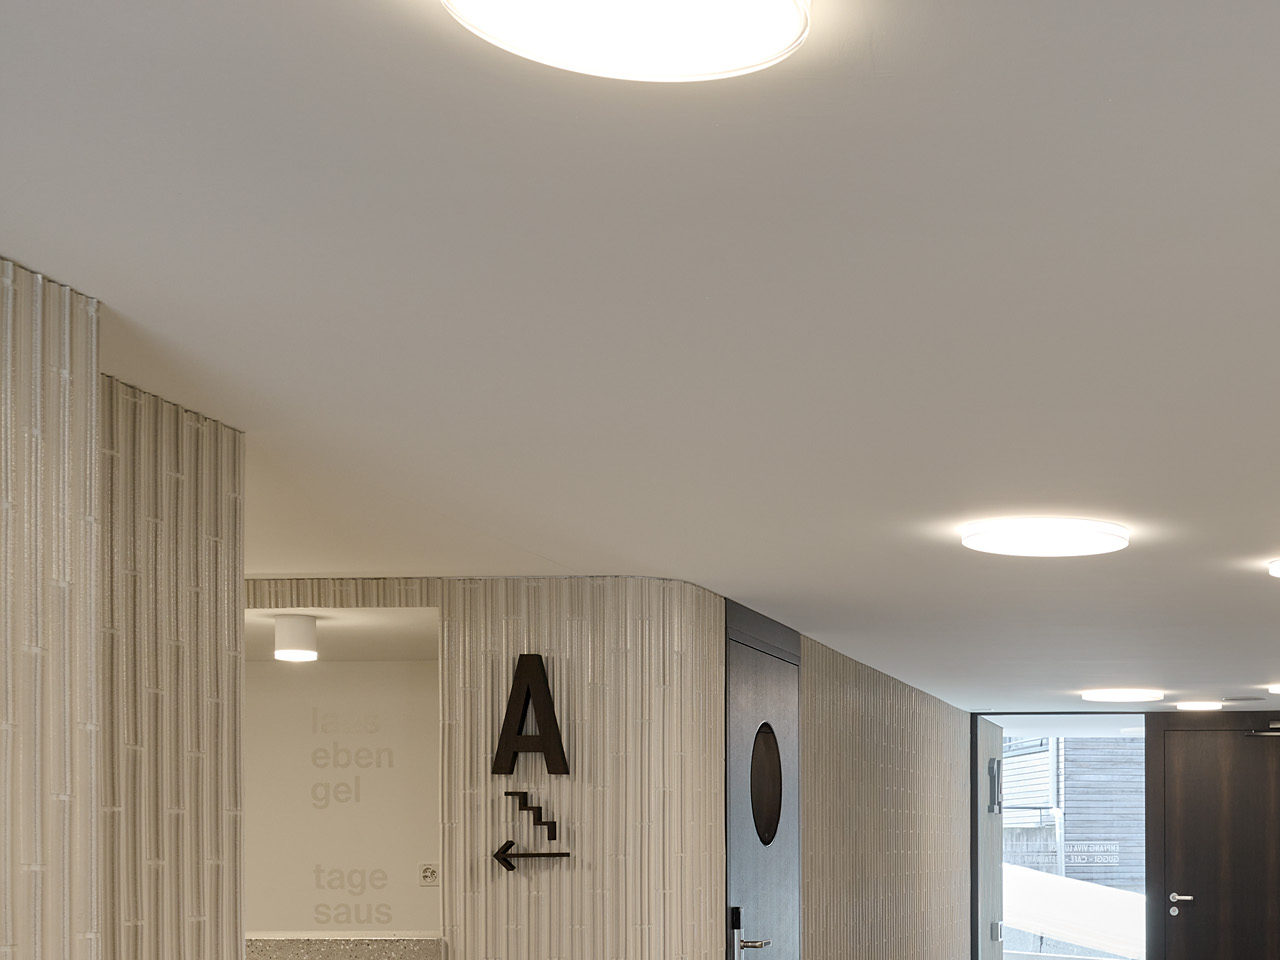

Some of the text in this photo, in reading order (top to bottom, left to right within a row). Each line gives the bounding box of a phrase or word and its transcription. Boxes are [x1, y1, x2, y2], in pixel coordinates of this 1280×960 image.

[491, 654, 570, 774] A
[311, 742, 394, 769] eben
[311, 775, 361, 810] gel
[313, 863, 388, 896] tage
[314, 902, 393, 925] saus
